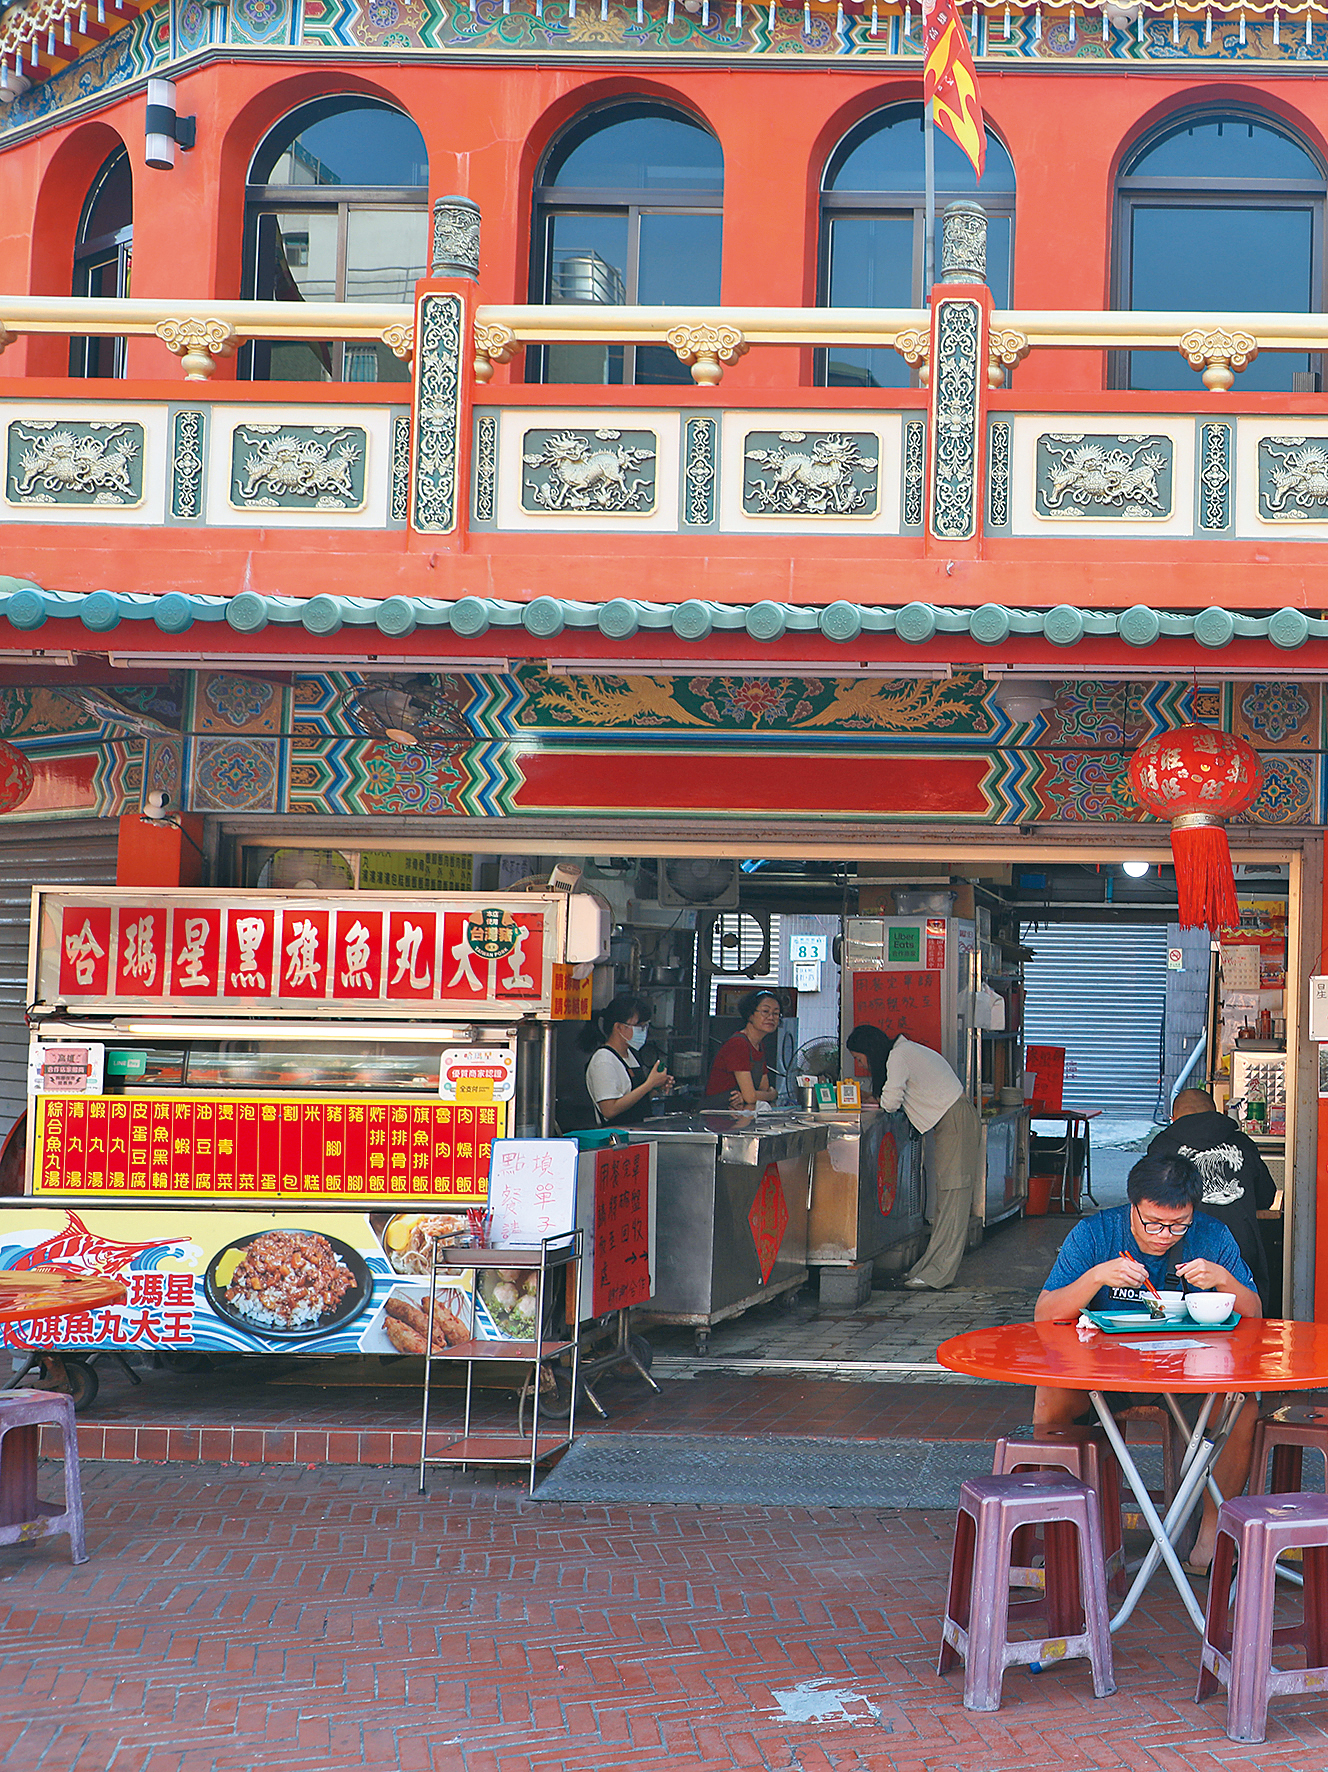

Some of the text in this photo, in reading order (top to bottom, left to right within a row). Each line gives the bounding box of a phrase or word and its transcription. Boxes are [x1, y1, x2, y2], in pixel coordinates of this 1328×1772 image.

[65, 916, 535, 992] 哈瑪星黑旗魚丸大王
[475, 946, 509, 957] TAIWAN PORK
[798, 946, 818, 957] 83
[893, 941, 914, 949] Eats
[45, 1102, 64, 1188] 綜合魚丸湯
[66, 1102, 85, 1188] 清丸湯
[87, 1102, 106, 1188] 蝦丸湯
[109, 1103, 127, 1188] 肉丸湯
[131, 1103, 148, 1188] 皮蛋豆腐
[152, 1103, 170, 1188] 旗魚黑輪
[195, 1104, 212, 1189] 油豆腐
[239, 1105, 256, 1190] 泡菜
[261, 1105, 277, 1190] 魯蛋
[282, 1106, 299, 1190] 割包
[304, 1106, 320, 1190] 米糕
[325, 1106, 342, 1191] 豬腳飯
[347, 1106, 364, 1191] 豬腳
[369, 1107, 386, 1191] 炸排骨飯
[412, 1107, 429, 1191] 旗魚排飯
[434, 1108, 451, 1192] 魯肉飯
[456, 1108, 473, 1192] 肉燥飯
[28, 1310, 193, 1343] 旗魚丸大王
